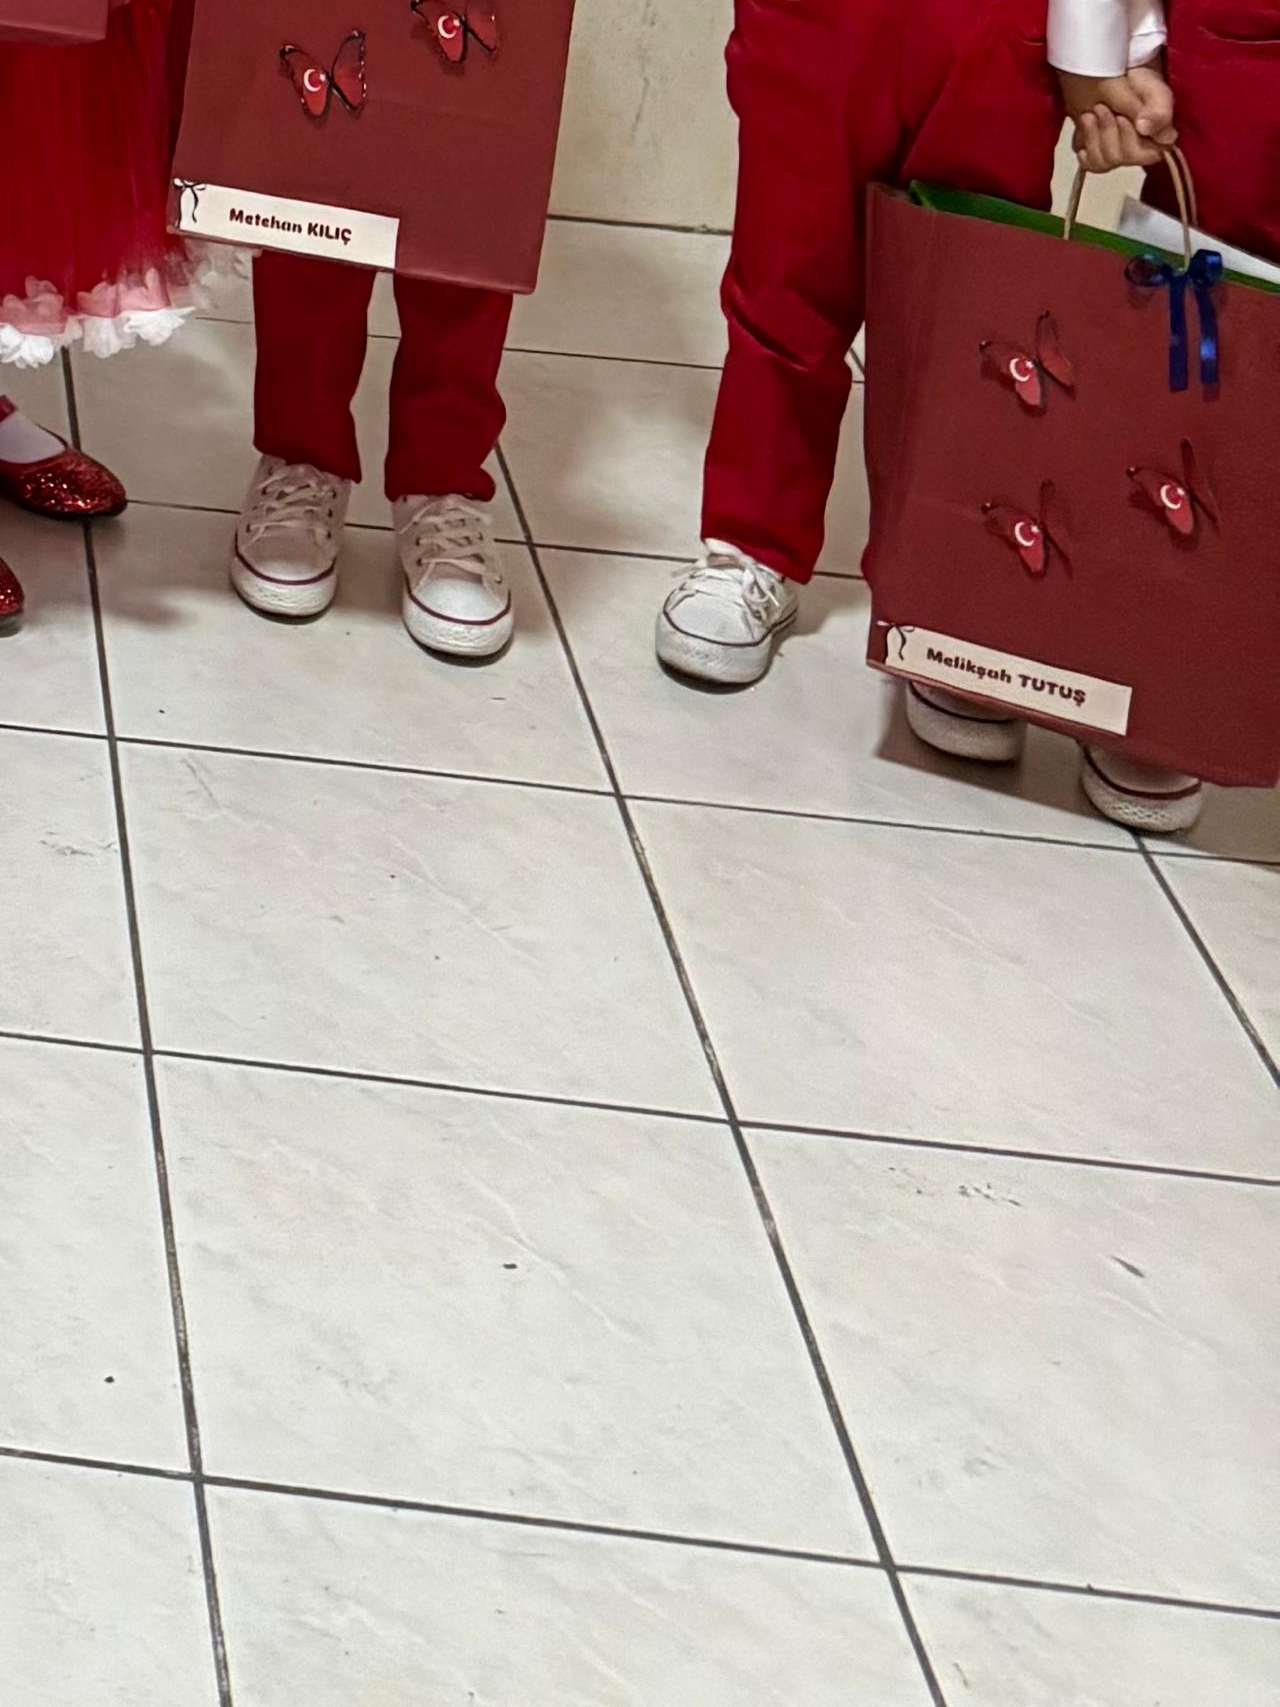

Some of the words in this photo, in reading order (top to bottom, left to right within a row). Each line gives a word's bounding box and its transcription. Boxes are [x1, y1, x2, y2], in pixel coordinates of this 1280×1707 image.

[307, 222, 352, 246] KILIÇ
[927, 647, 1012, 683] Melikşah
[1018, 674, 1087, 707] TUTUŞ
